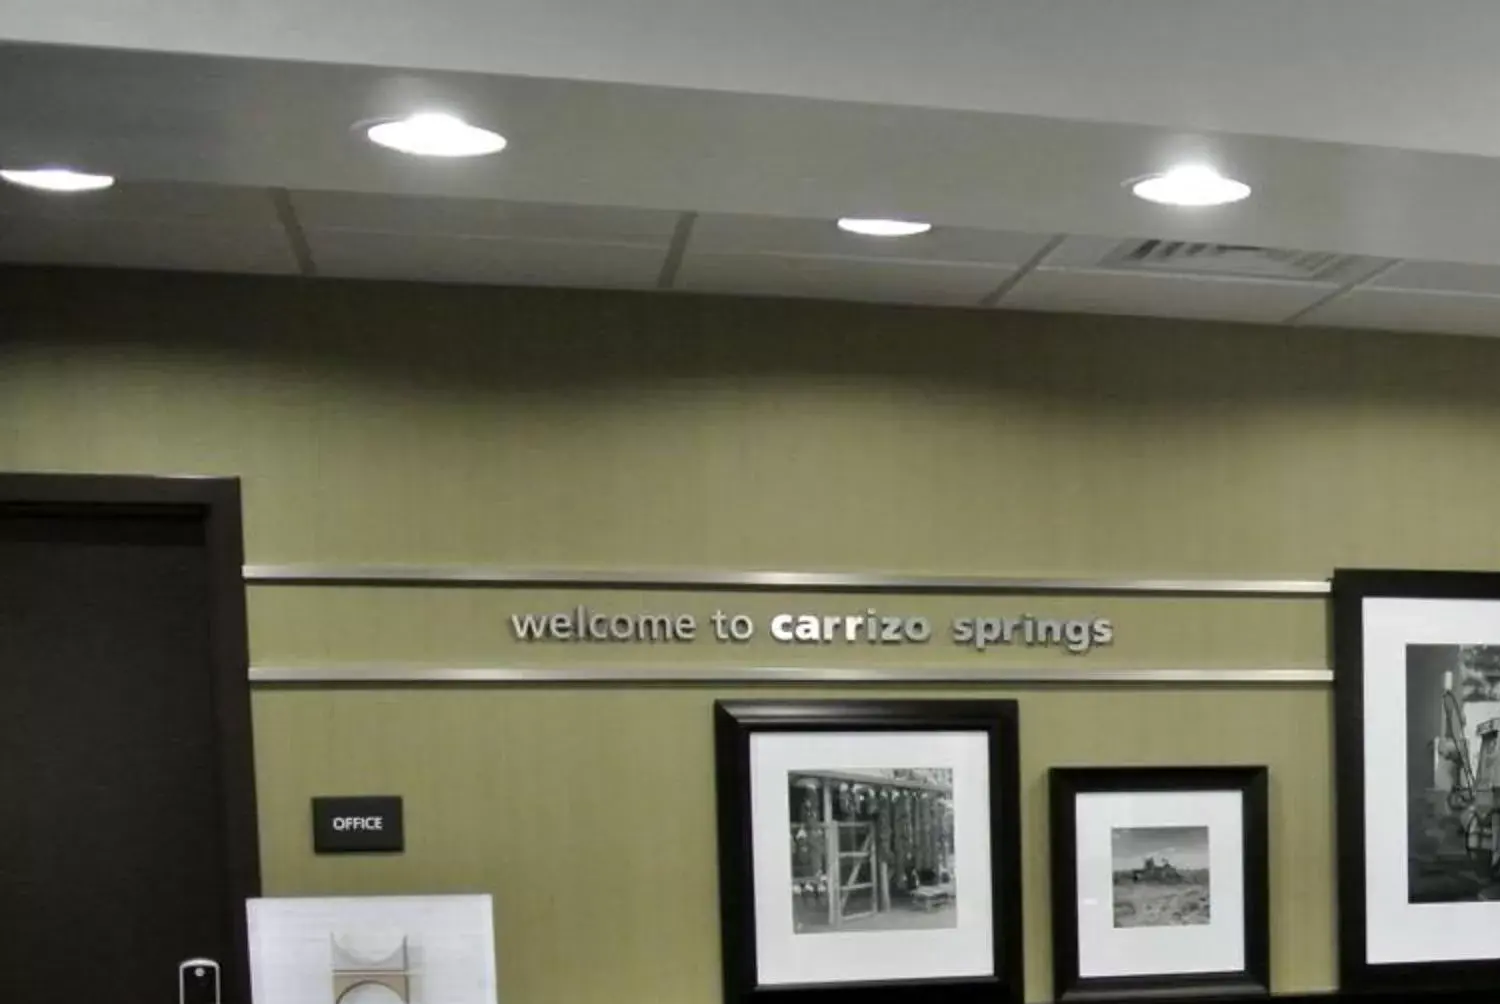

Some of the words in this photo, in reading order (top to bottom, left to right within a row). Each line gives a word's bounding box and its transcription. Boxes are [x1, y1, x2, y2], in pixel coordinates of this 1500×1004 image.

[512, 605, 697, 641] welcome
[711, 609, 754, 639] to
[769, 608, 932, 644] carrizo
[953, 612, 1114, 651] springs
[332, 816, 383, 831] OFFICE
